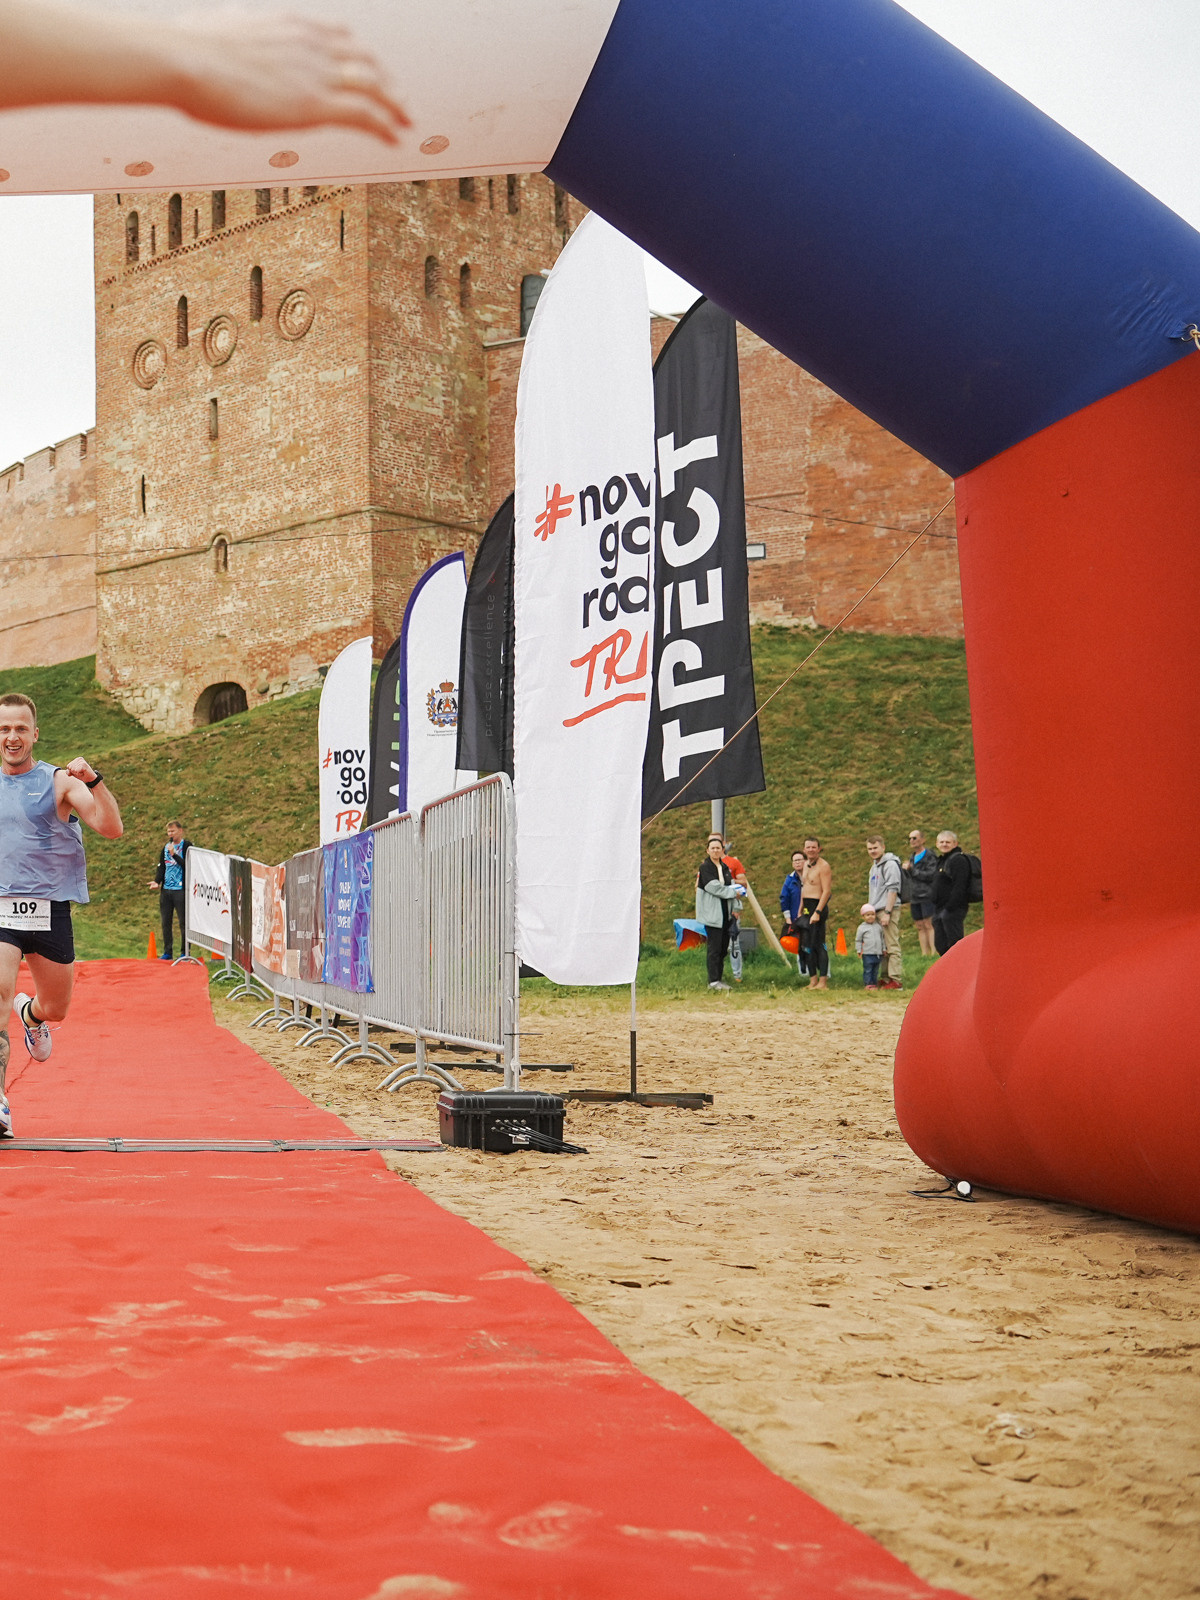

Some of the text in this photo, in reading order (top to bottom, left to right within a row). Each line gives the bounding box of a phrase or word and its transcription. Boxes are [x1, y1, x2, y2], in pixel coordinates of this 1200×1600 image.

[534, 472, 651, 542] #nov
[599, 516, 651, 578] go
[581, 554, 650, 629] rod
[657, 431, 725, 783] ТРЕСТ
[322, 748, 366, 769] #nov
[340, 766, 366, 788] go
[336, 781, 368, 805] od
[335, 809, 362, 833] TR
[12, 901, 37, 915] 109
